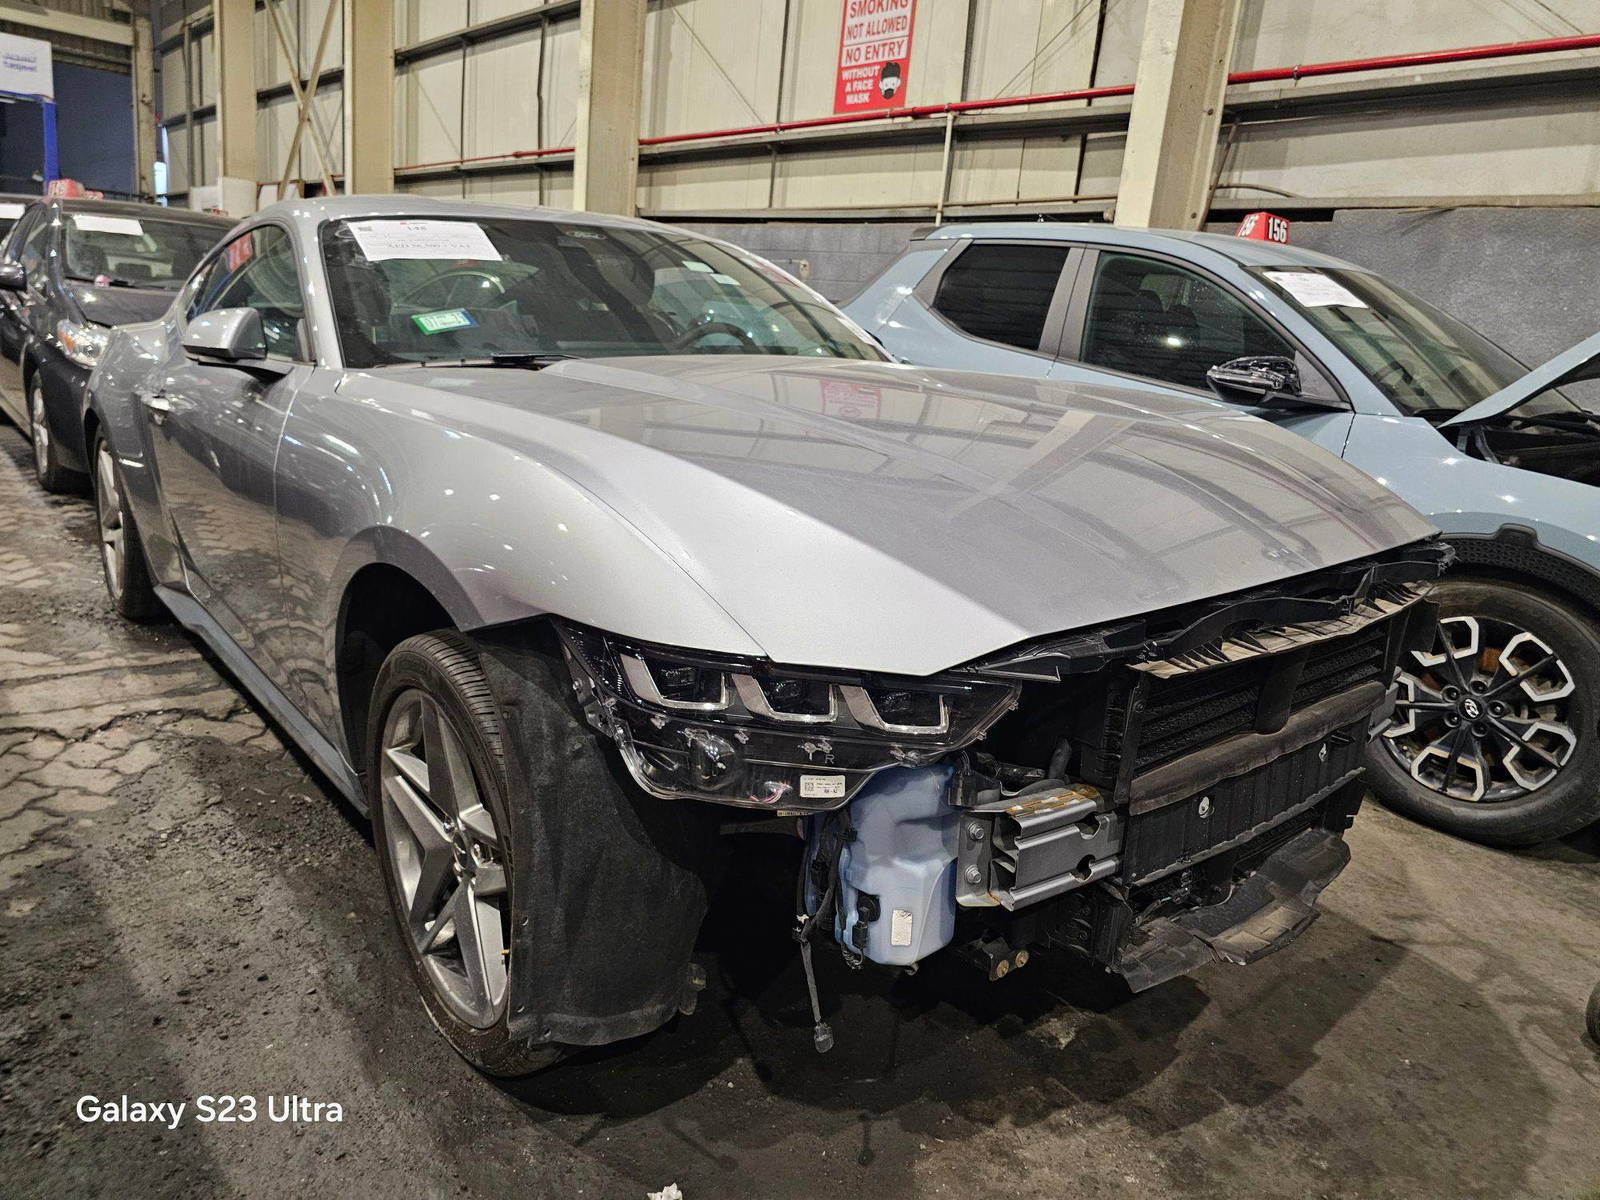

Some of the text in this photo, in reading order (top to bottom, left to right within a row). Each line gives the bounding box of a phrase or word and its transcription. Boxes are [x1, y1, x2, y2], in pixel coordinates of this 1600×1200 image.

[850, 0, 908, 18] SMOKING
[846, 15, 908, 40] NOT ALLOWED
[845, 40, 905, 63] NO ENTRY
[842, 65, 880, 80] WITHOUT
[845, 79, 873, 92] A FACE
[846, 92, 870, 104] MASK
[1268, 216, 1287, 243] 156
